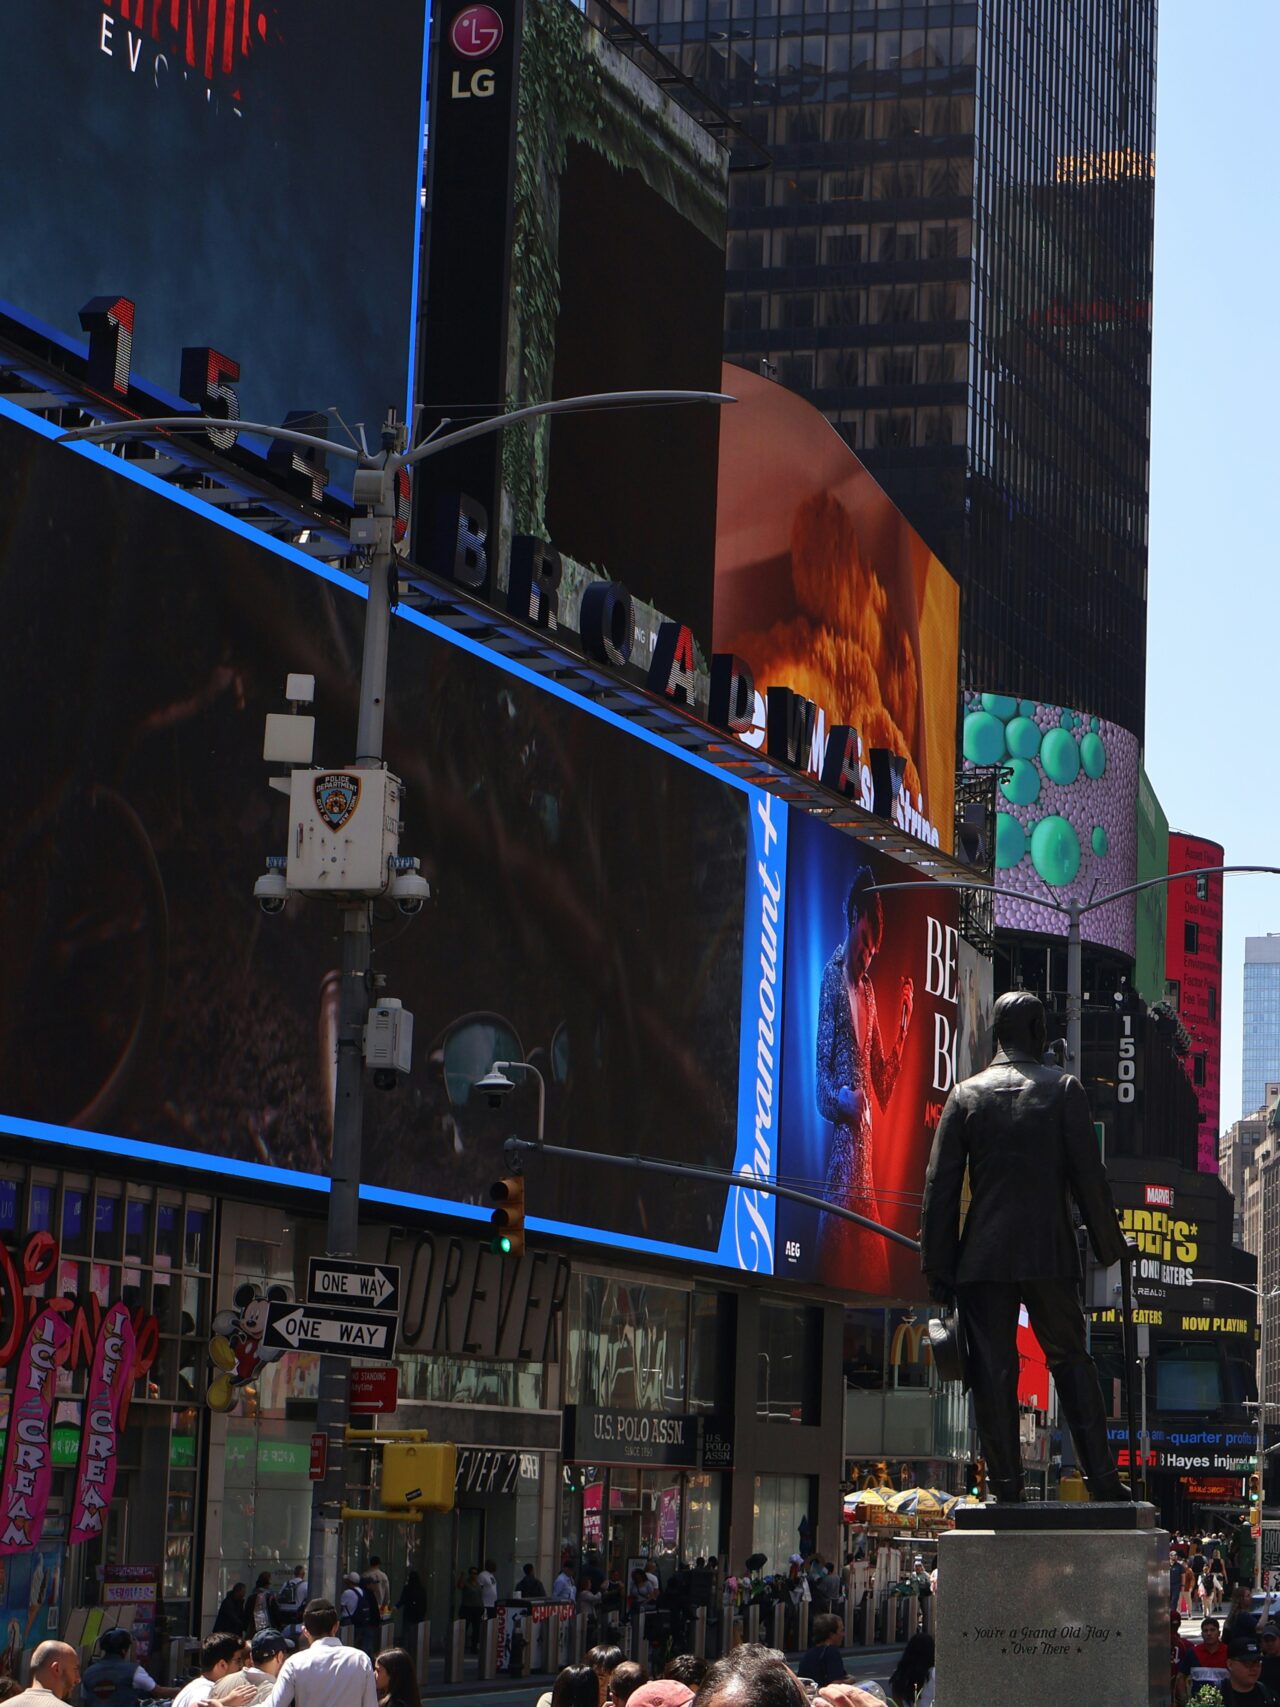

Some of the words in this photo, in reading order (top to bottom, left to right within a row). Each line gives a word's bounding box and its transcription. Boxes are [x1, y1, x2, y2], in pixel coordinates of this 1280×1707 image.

[451, 69, 495, 99] LG
[440, 488, 906, 822] BROADWAY
[316, 781, 358, 792] DEPARTMENT
[325, 775, 350, 783] POLICE
[389, 856, 415, 869] NYPD
[1118, 1015, 1136, 1103] 1500
[785, 1240, 801, 1257] AEG
[321, 1273, 348, 1293] ONE
[360, 1276, 386, 1298] WAY
[285, 1317, 322, 1338] ONE
[339, 1323, 379, 1346] WAY
[1182, 1316, 1211, 1331] NOW
[1213, 1318, 1248, 1333] PLAYING
[28, 1316, 57, 1392] ICE
[101, 1311, 128, 1386] ICE
[361, 1371, 387, 1382] STANDING
[594, 1413, 615, 1441] U.S.
[617, 1415, 649, 1443] POLO
[651, 1418, 685, 1446] ASSN.
[706, 1433, 722, 1442] U.S.
[705, 1442, 731, 1451] POLO
[75, 1410, 116, 1530] CREAM
[1167, 1453, 1210, 1470] Hayes
[1, 1417, 49, 1546] CREAM
[974, 1626, 1005, 1642] You're
[1009, 1629, 1017, 1639] a
[1020, 1626, 1057, 1641] Grand
[1060, 1626, 1081, 1639] Old
[1084, 1625, 1110, 1642] Flag
[1010, 1641, 1038, 1655] Over
[1040, 1641, 1070, 1655] There
